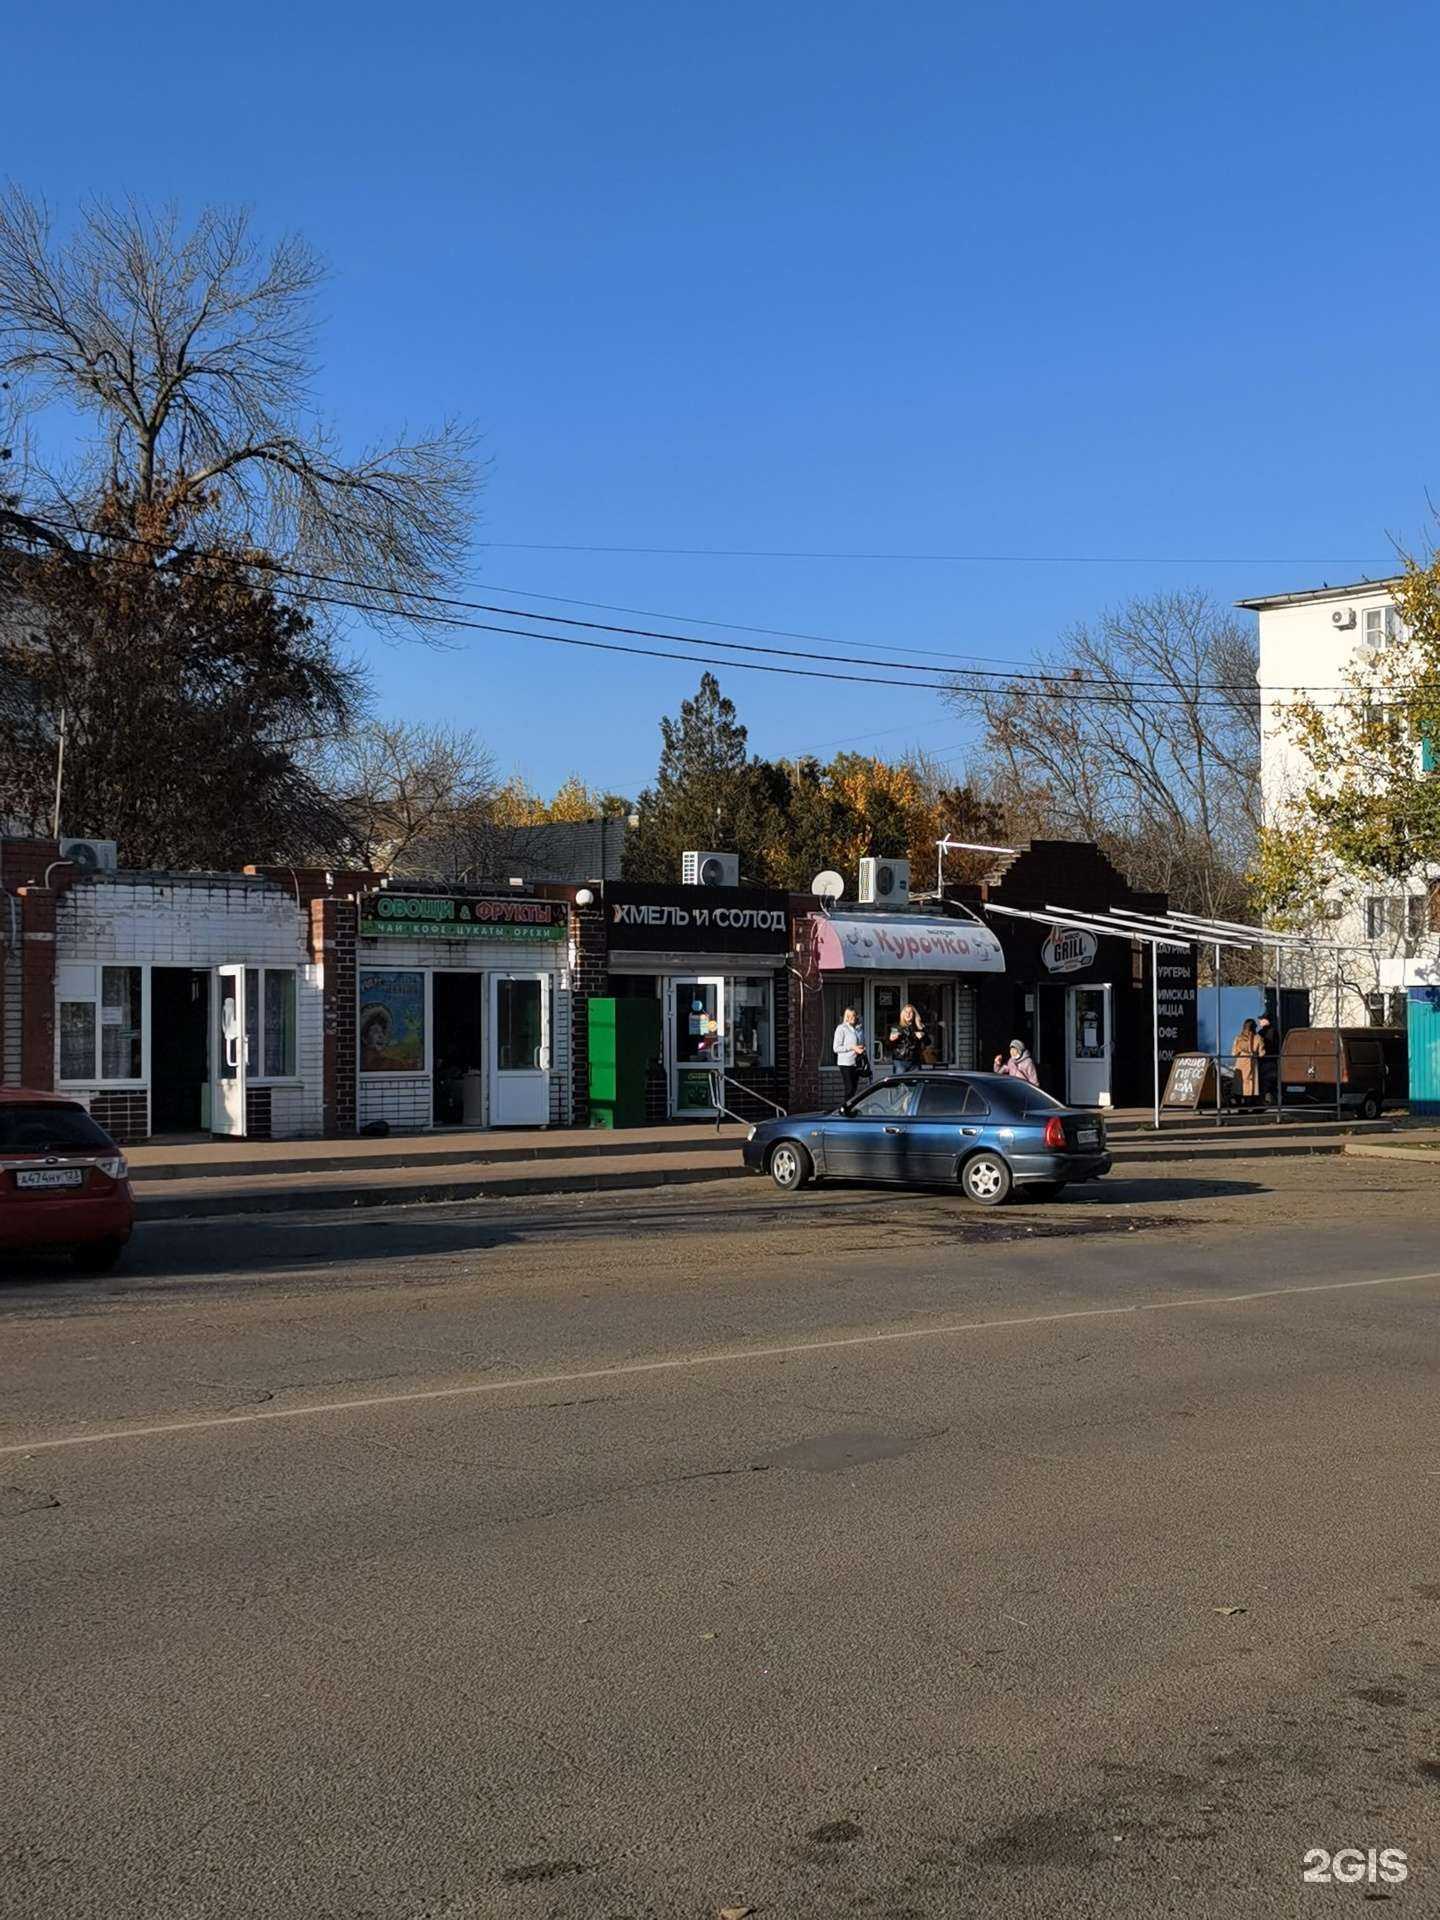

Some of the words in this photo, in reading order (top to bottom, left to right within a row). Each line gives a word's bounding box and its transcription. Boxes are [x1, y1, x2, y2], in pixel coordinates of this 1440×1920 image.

[377, 898, 455, 921] ОВОЩИ
[475, 901, 551, 922] ФРУКТЫ
[612, 904, 690, 926] ХМЕЛЬ
[713, 907, 787, 932] СОЛОД
[414, 924, 446, 935] КОФЕ
[457, 926, 503, 936] ЦУКАТЫ
[514, 928, 550, 938] ОРЕХИ
[873, 927, 970, 959] Курочка
[1054, 937, 1084, 963] GRILL
[1157, 966, 1191, 978] УРГЕРЫ
[1157, 988, 1195, 1001] ИМСКАЯ
[1157, 1003, 1184, 1017] ИЦЦА
[1158, 1026, 1178, 1039] ОФЕ
